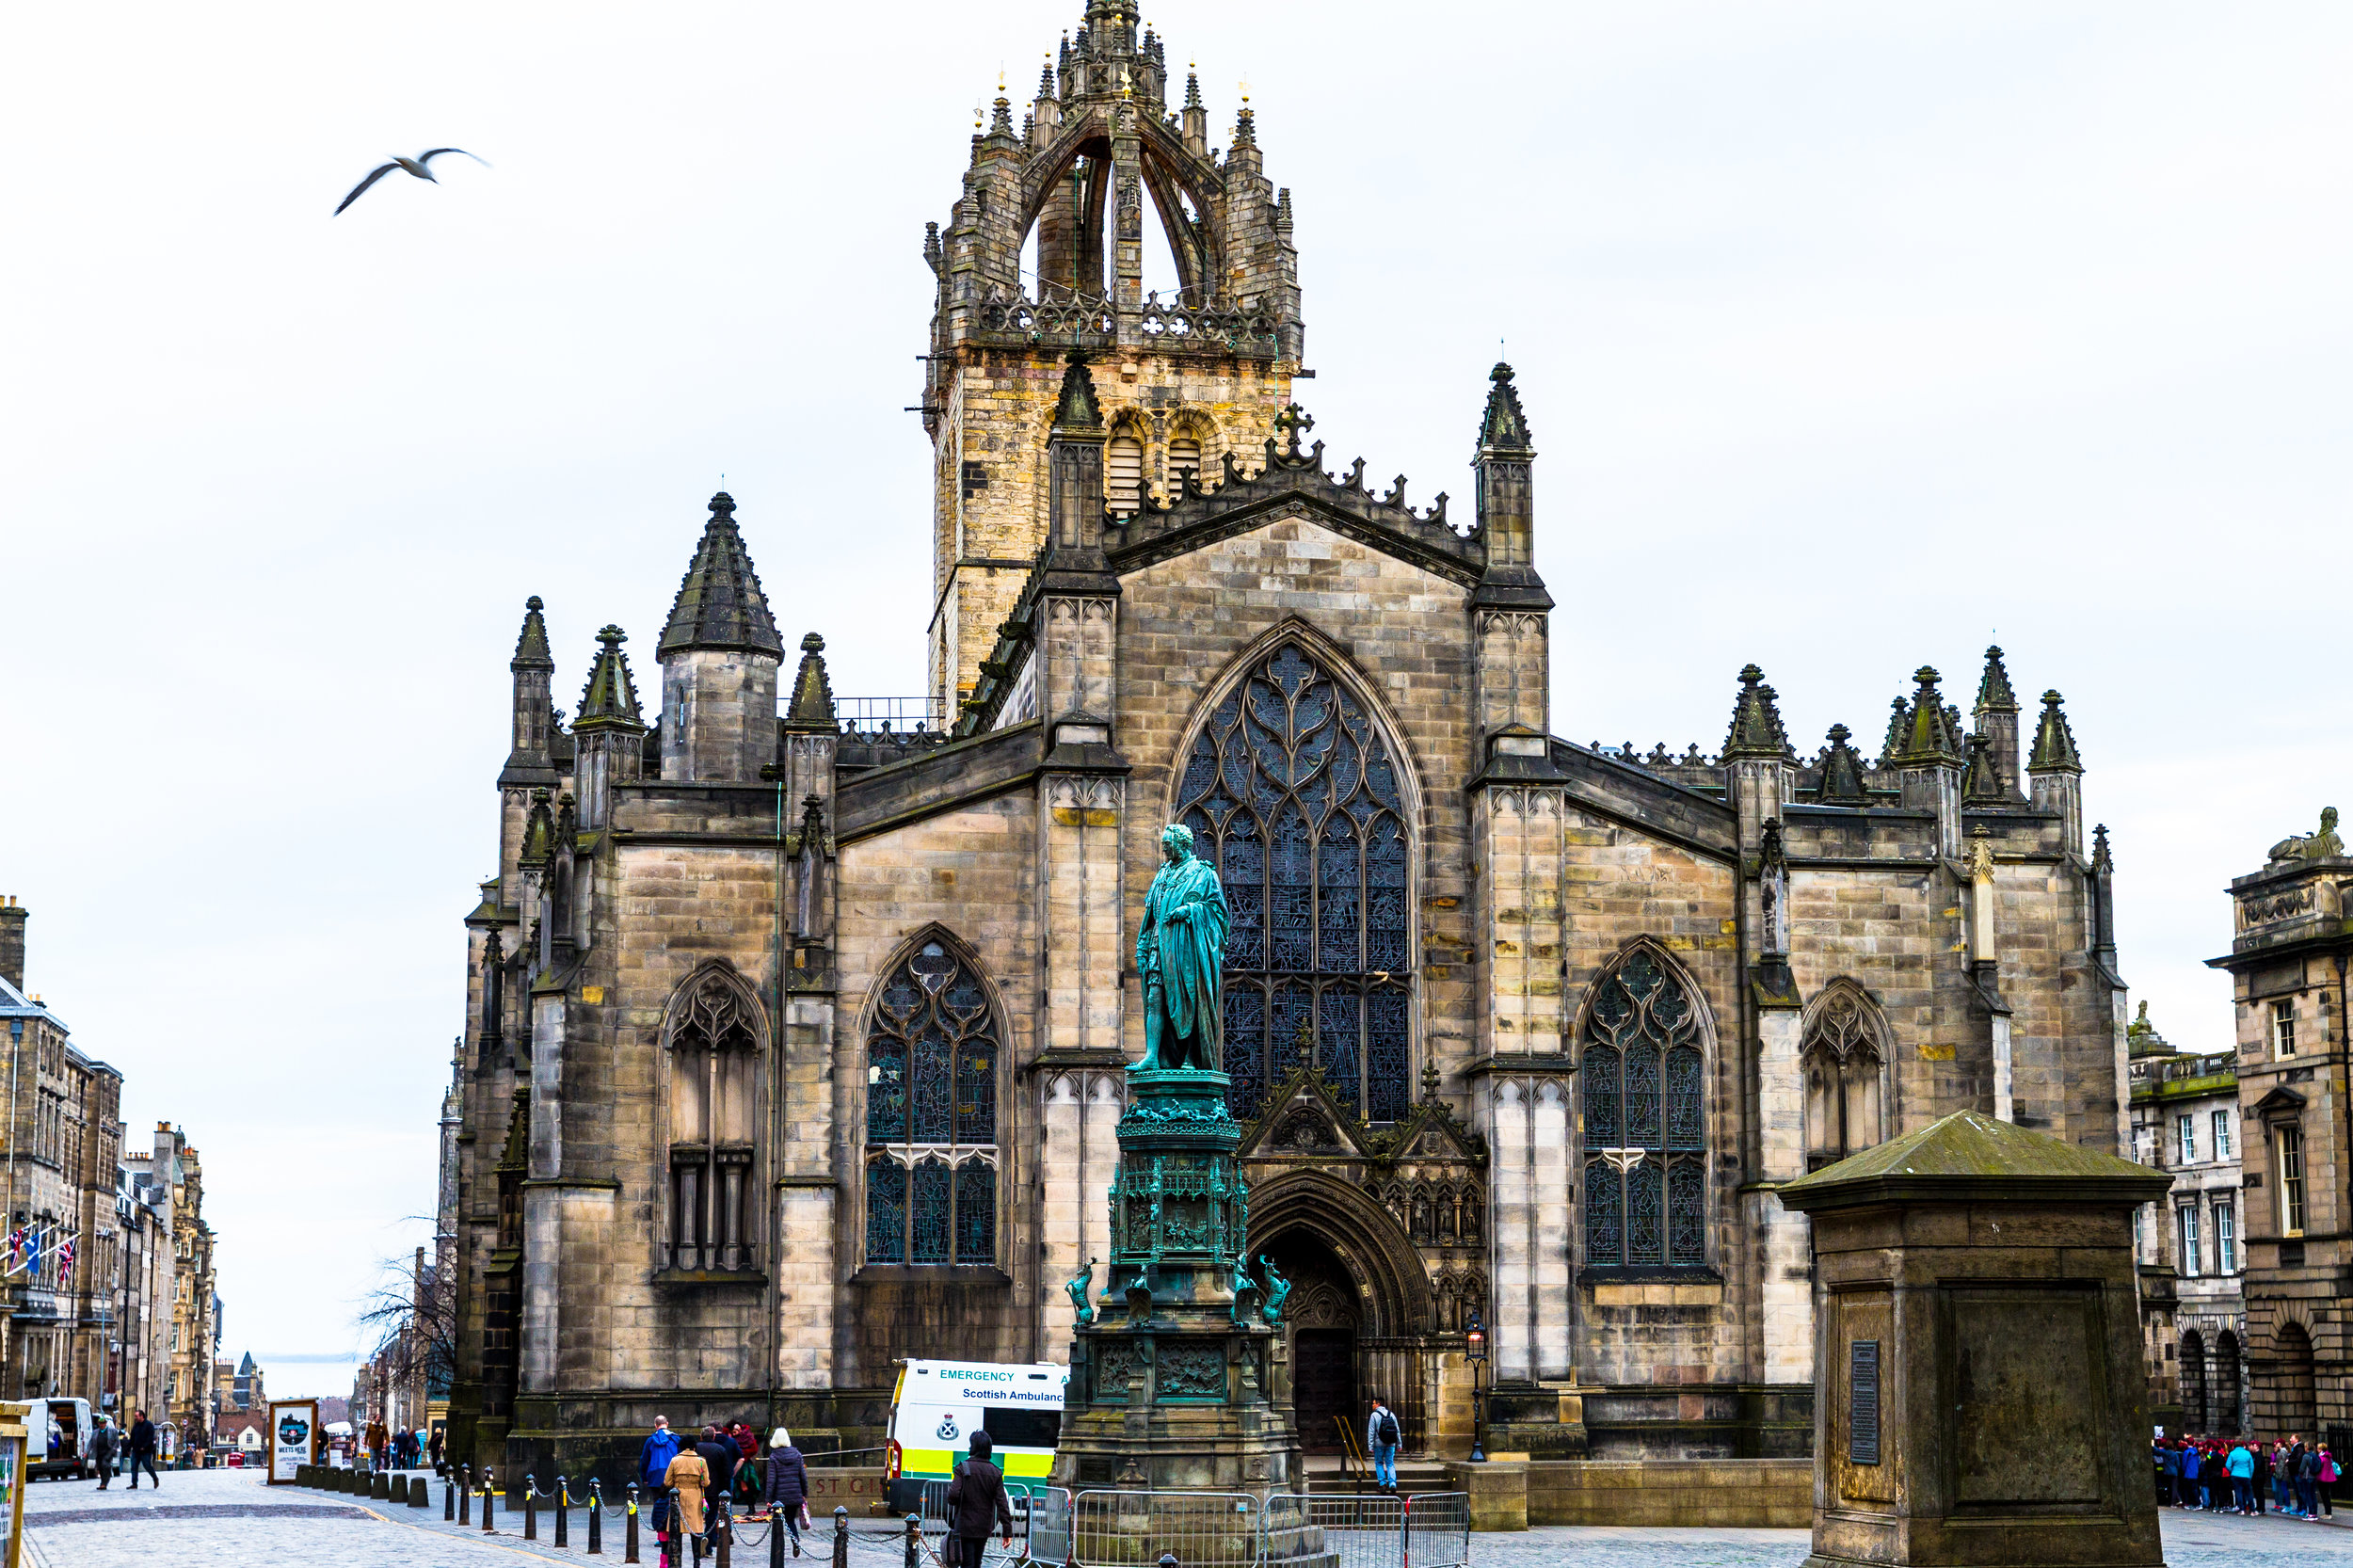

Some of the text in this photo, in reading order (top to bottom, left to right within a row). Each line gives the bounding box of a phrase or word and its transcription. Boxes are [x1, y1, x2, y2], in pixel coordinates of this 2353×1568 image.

[939, 1369, 1015, 1382] EMERGENCY
[963, 1388, 1063, 1402] Scottish Ambulanc
[816, 1478, 883, 1494] ST GI
